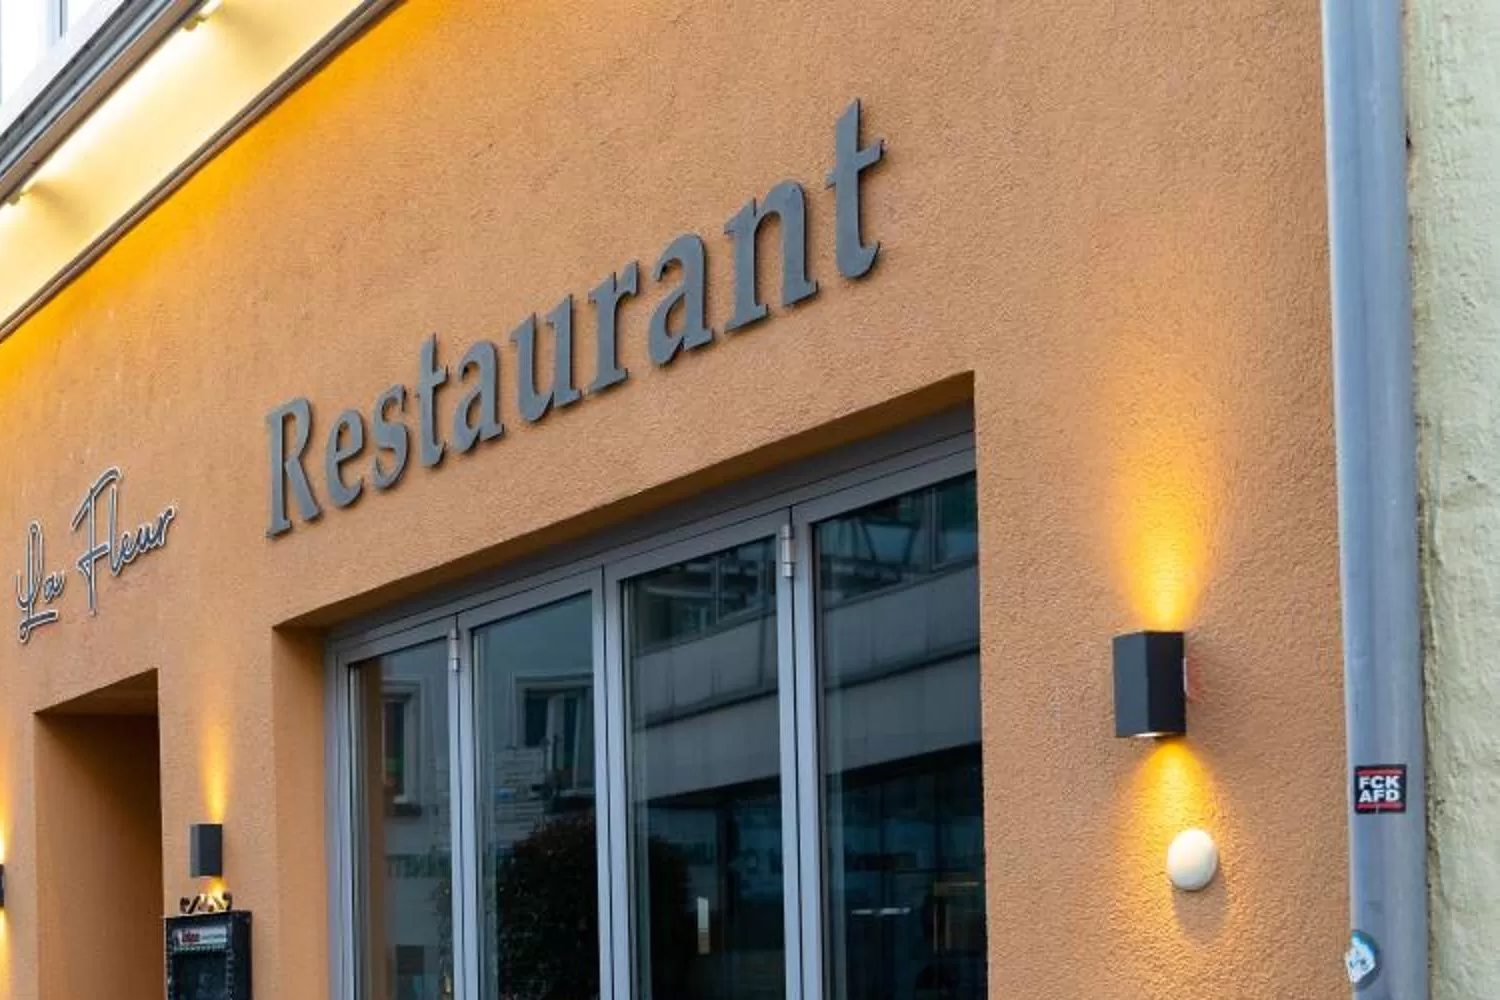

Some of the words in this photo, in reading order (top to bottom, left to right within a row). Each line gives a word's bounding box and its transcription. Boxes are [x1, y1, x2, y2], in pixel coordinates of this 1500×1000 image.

[265, 97, 886, 538] Restaurant
[14, 519, 66, 645] La
[71, 466, 178, 616] Fleur
[1359, 775, 1401, 790] FCK
[1359, 790, 1400, 803] AFD
